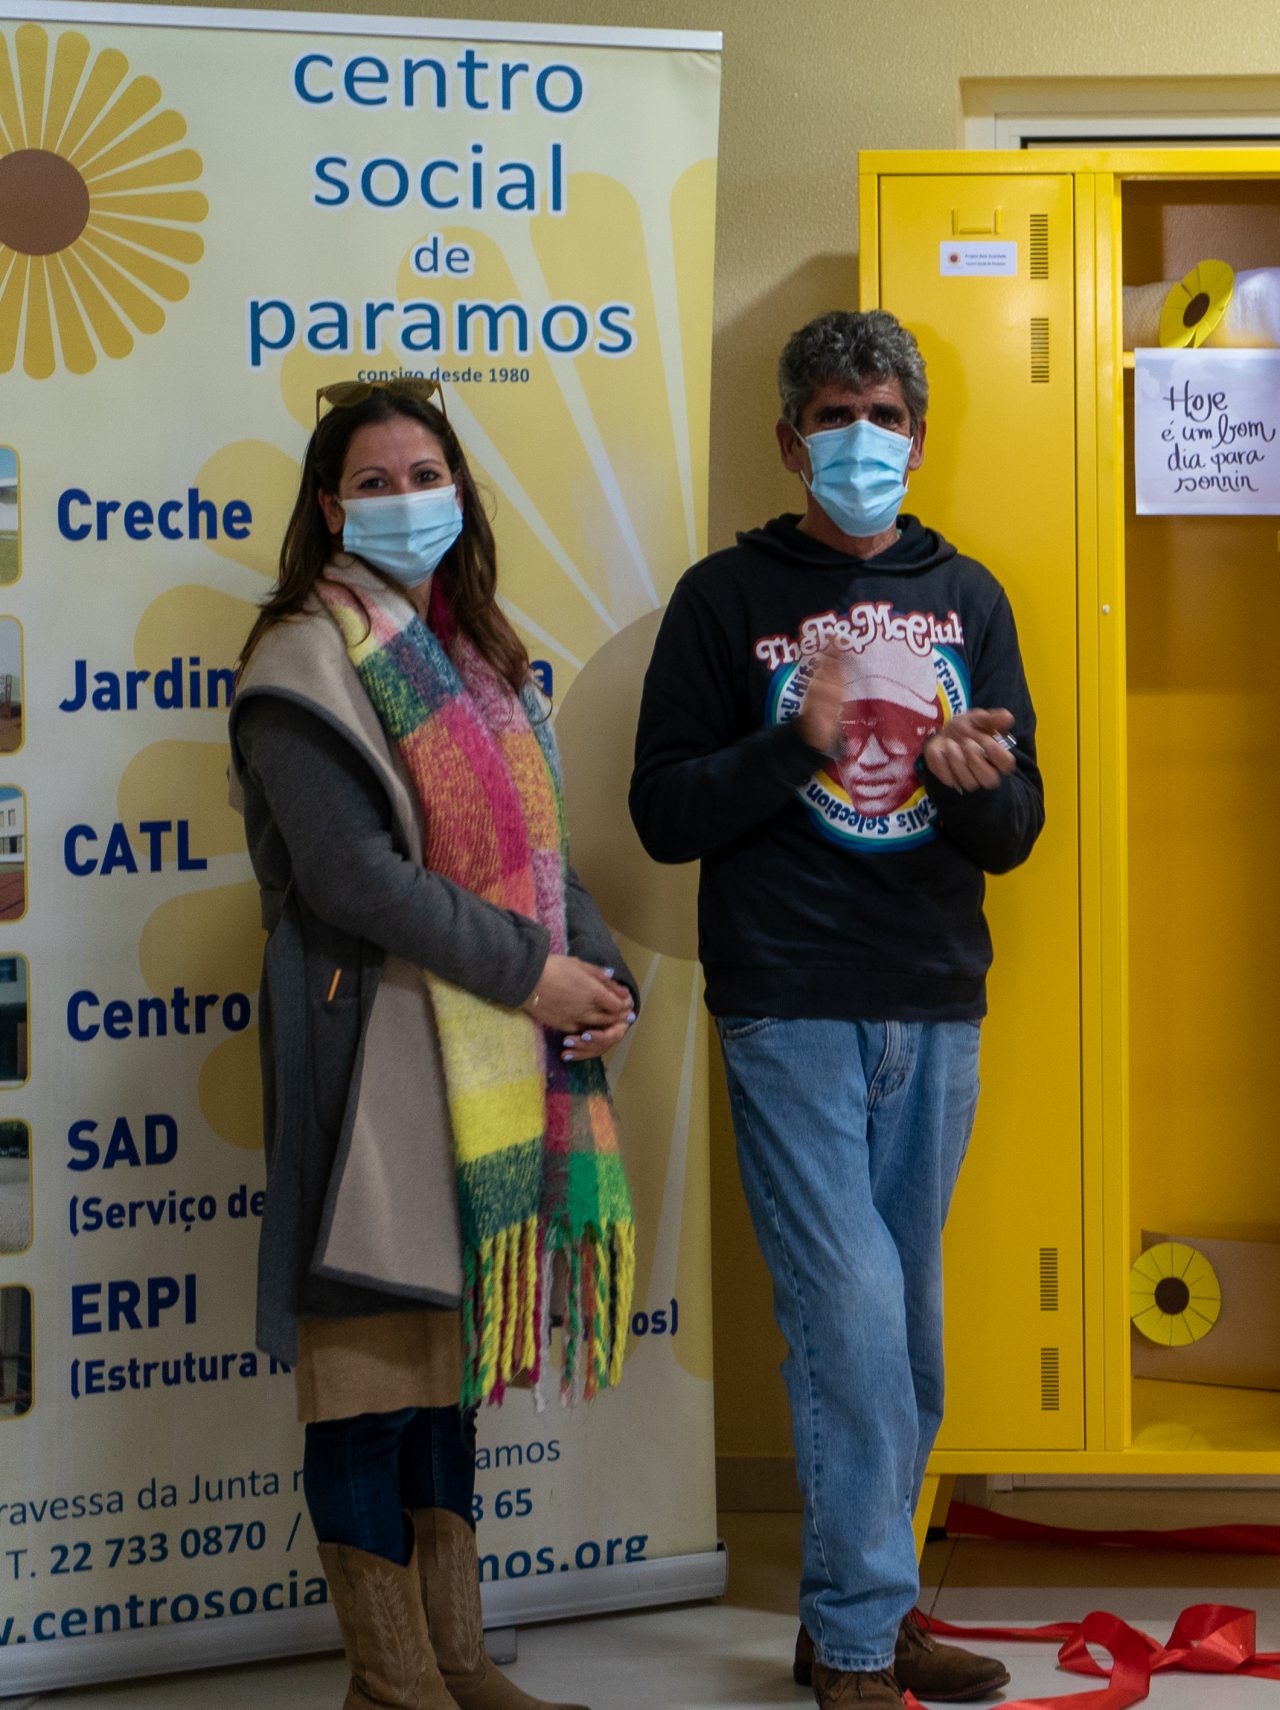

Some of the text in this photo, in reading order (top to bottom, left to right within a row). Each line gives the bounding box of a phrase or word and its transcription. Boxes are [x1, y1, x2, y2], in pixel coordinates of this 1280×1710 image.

[293, 49, 583, 113] centro
[314, 143, 561, 211] social
[414, 236, 470, 273] de
[249, 299, 633, 367] paramos
[357, 366, 530, 386] consigo desde 1980
[1163, 380, 1228, 422] Hoje
[1161, 413, 1276, 449] é um bom
[1168, 443, 1265, 473] dia para
[57, 488, 253, 541] Creche
[806, 783, 890, 836] Selection
[64, 820, 208, 877] CATL
[66, 986, 251, 1042] Centro
[66, 1114, 179, 1171] SAD
[69, 1189, 218, 1237] (Serviço
[71, 1273, 197, 1336] ERPI
[71, 1350, 258, 1399] (Estrutura
[475, 1439, 560, 1471] amos
[137, 1477, 177, 1510] da
[188, 1469, 280, 1504] Junta
[494, 1487, 533, 1520] 65
[6, 1548, 37, 1580] T.
[50, 1540, 93, 1575] 22
[104, 1531, 169, 1569] 733
[180, 1520, 267, 1560] 0870
